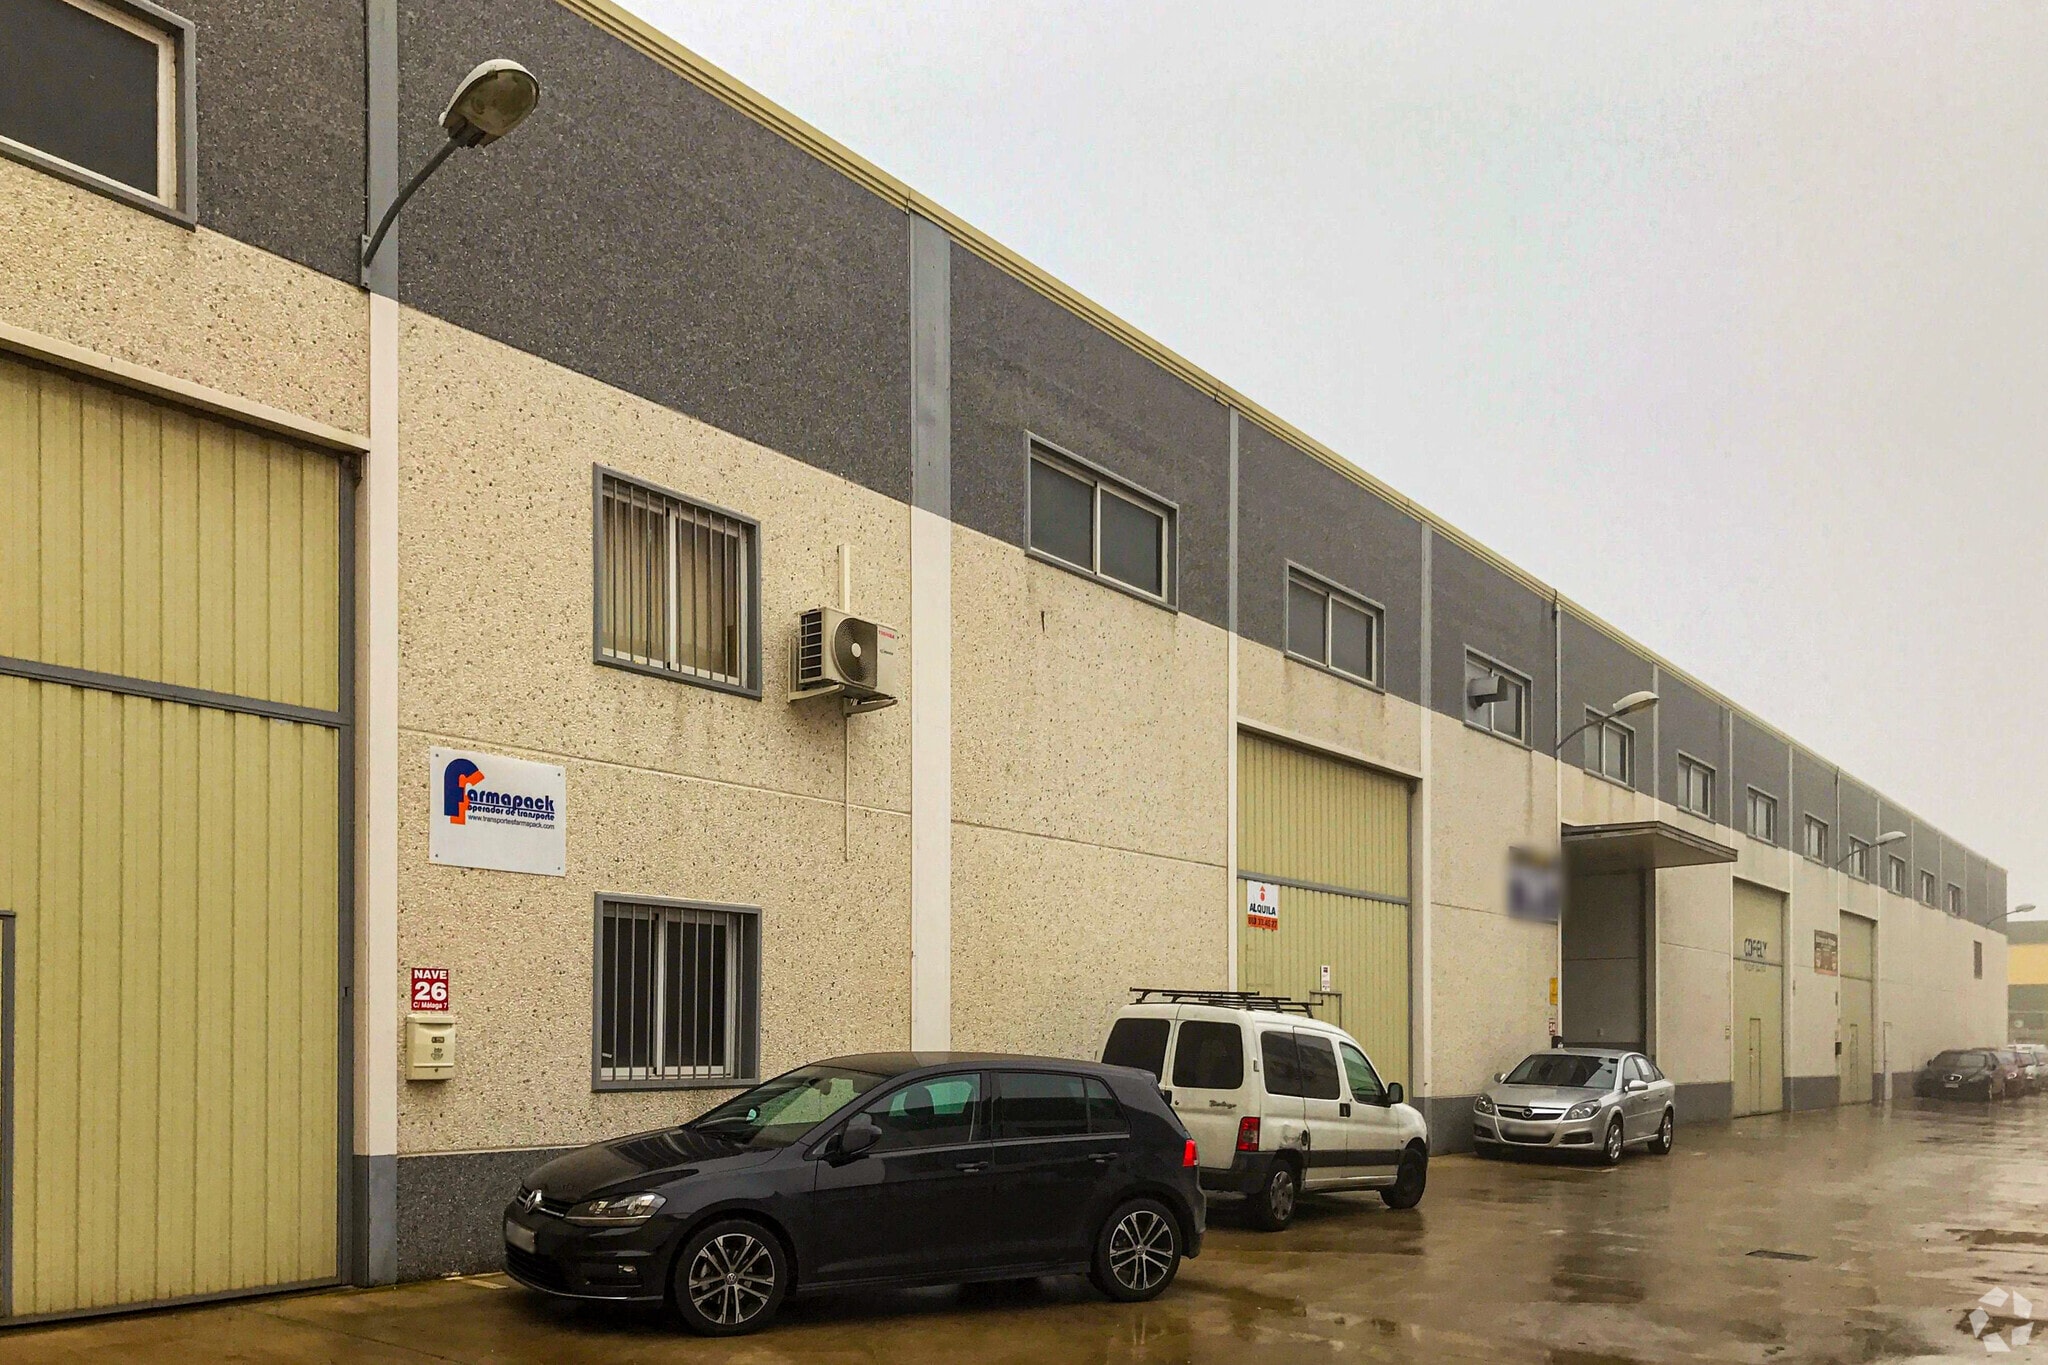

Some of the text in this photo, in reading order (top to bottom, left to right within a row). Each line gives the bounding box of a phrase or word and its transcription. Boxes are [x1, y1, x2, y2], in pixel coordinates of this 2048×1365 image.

[468, 804, 555, 821] operador de transporte
[468, 814, 555, 830] www.transportesfarmapack.com
[1249, 902, 1277, 916] ALQUILA
[414, 969, 447, 980] NAVE
[414, 981, 447, 1001] 26
